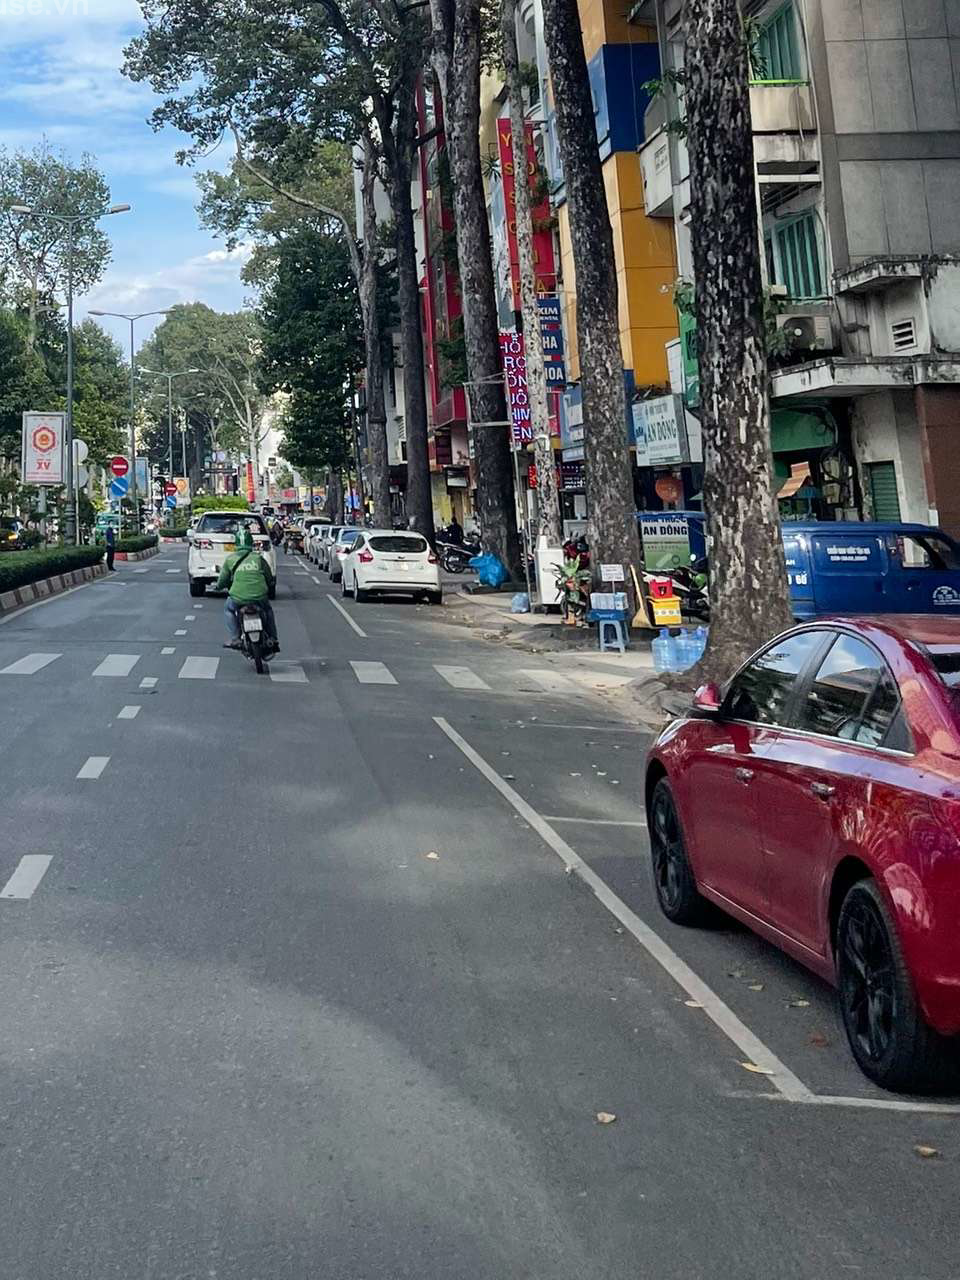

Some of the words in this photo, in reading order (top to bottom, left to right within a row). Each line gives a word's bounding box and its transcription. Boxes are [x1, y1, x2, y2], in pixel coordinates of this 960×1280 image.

[543, 336, 558, 349] HA
[545, 368, 564, 380] OA
[643, 526, 657, 535] AN
